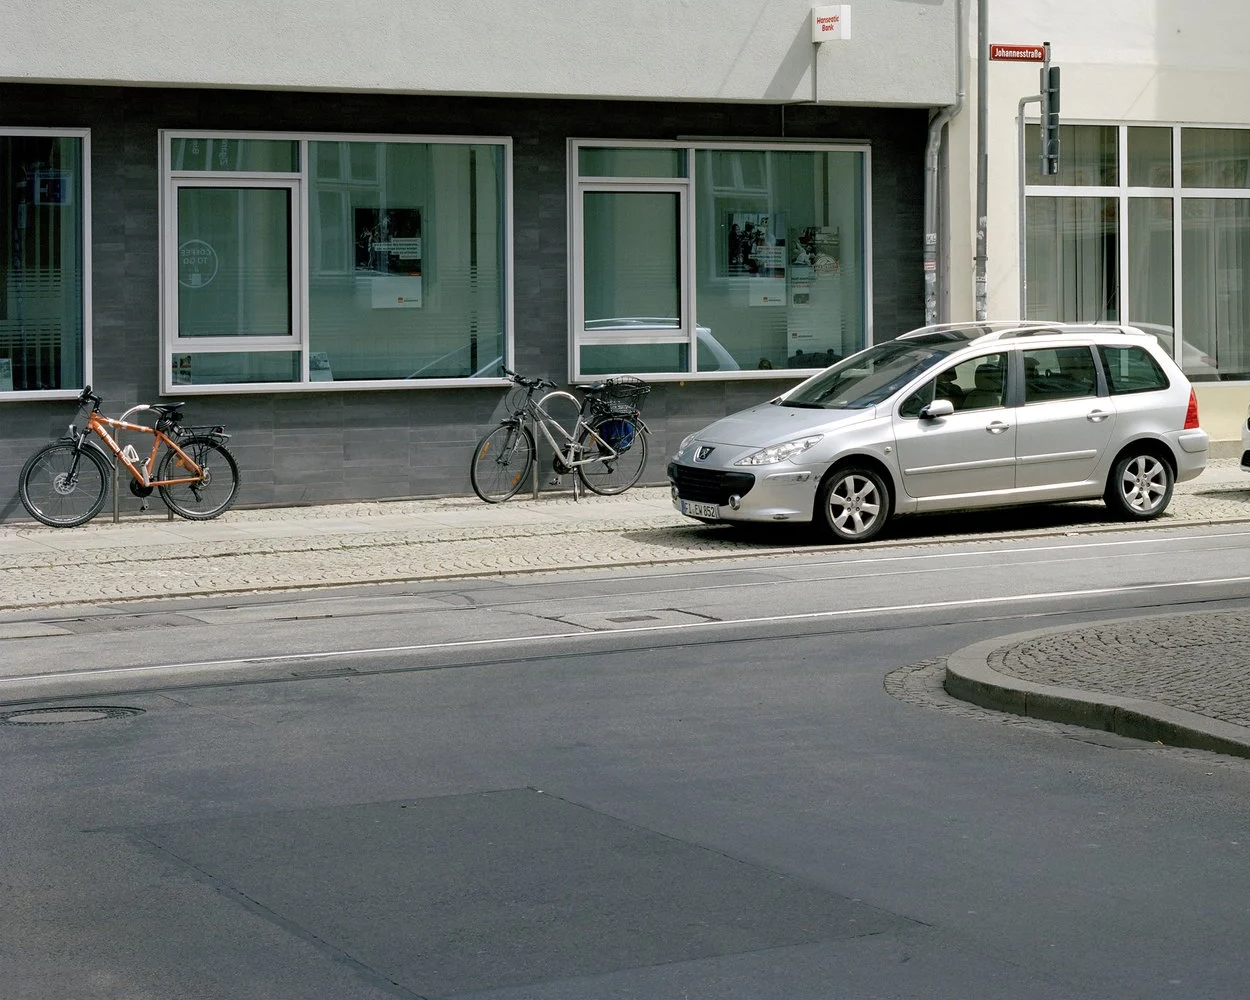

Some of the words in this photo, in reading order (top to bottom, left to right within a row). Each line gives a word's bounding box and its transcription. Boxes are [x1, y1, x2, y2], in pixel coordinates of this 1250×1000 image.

[821, 24, 835, 32] Bank
[994, 47, 1042, 59] Johannesstraße
[703, 505, 716, 518] 852
